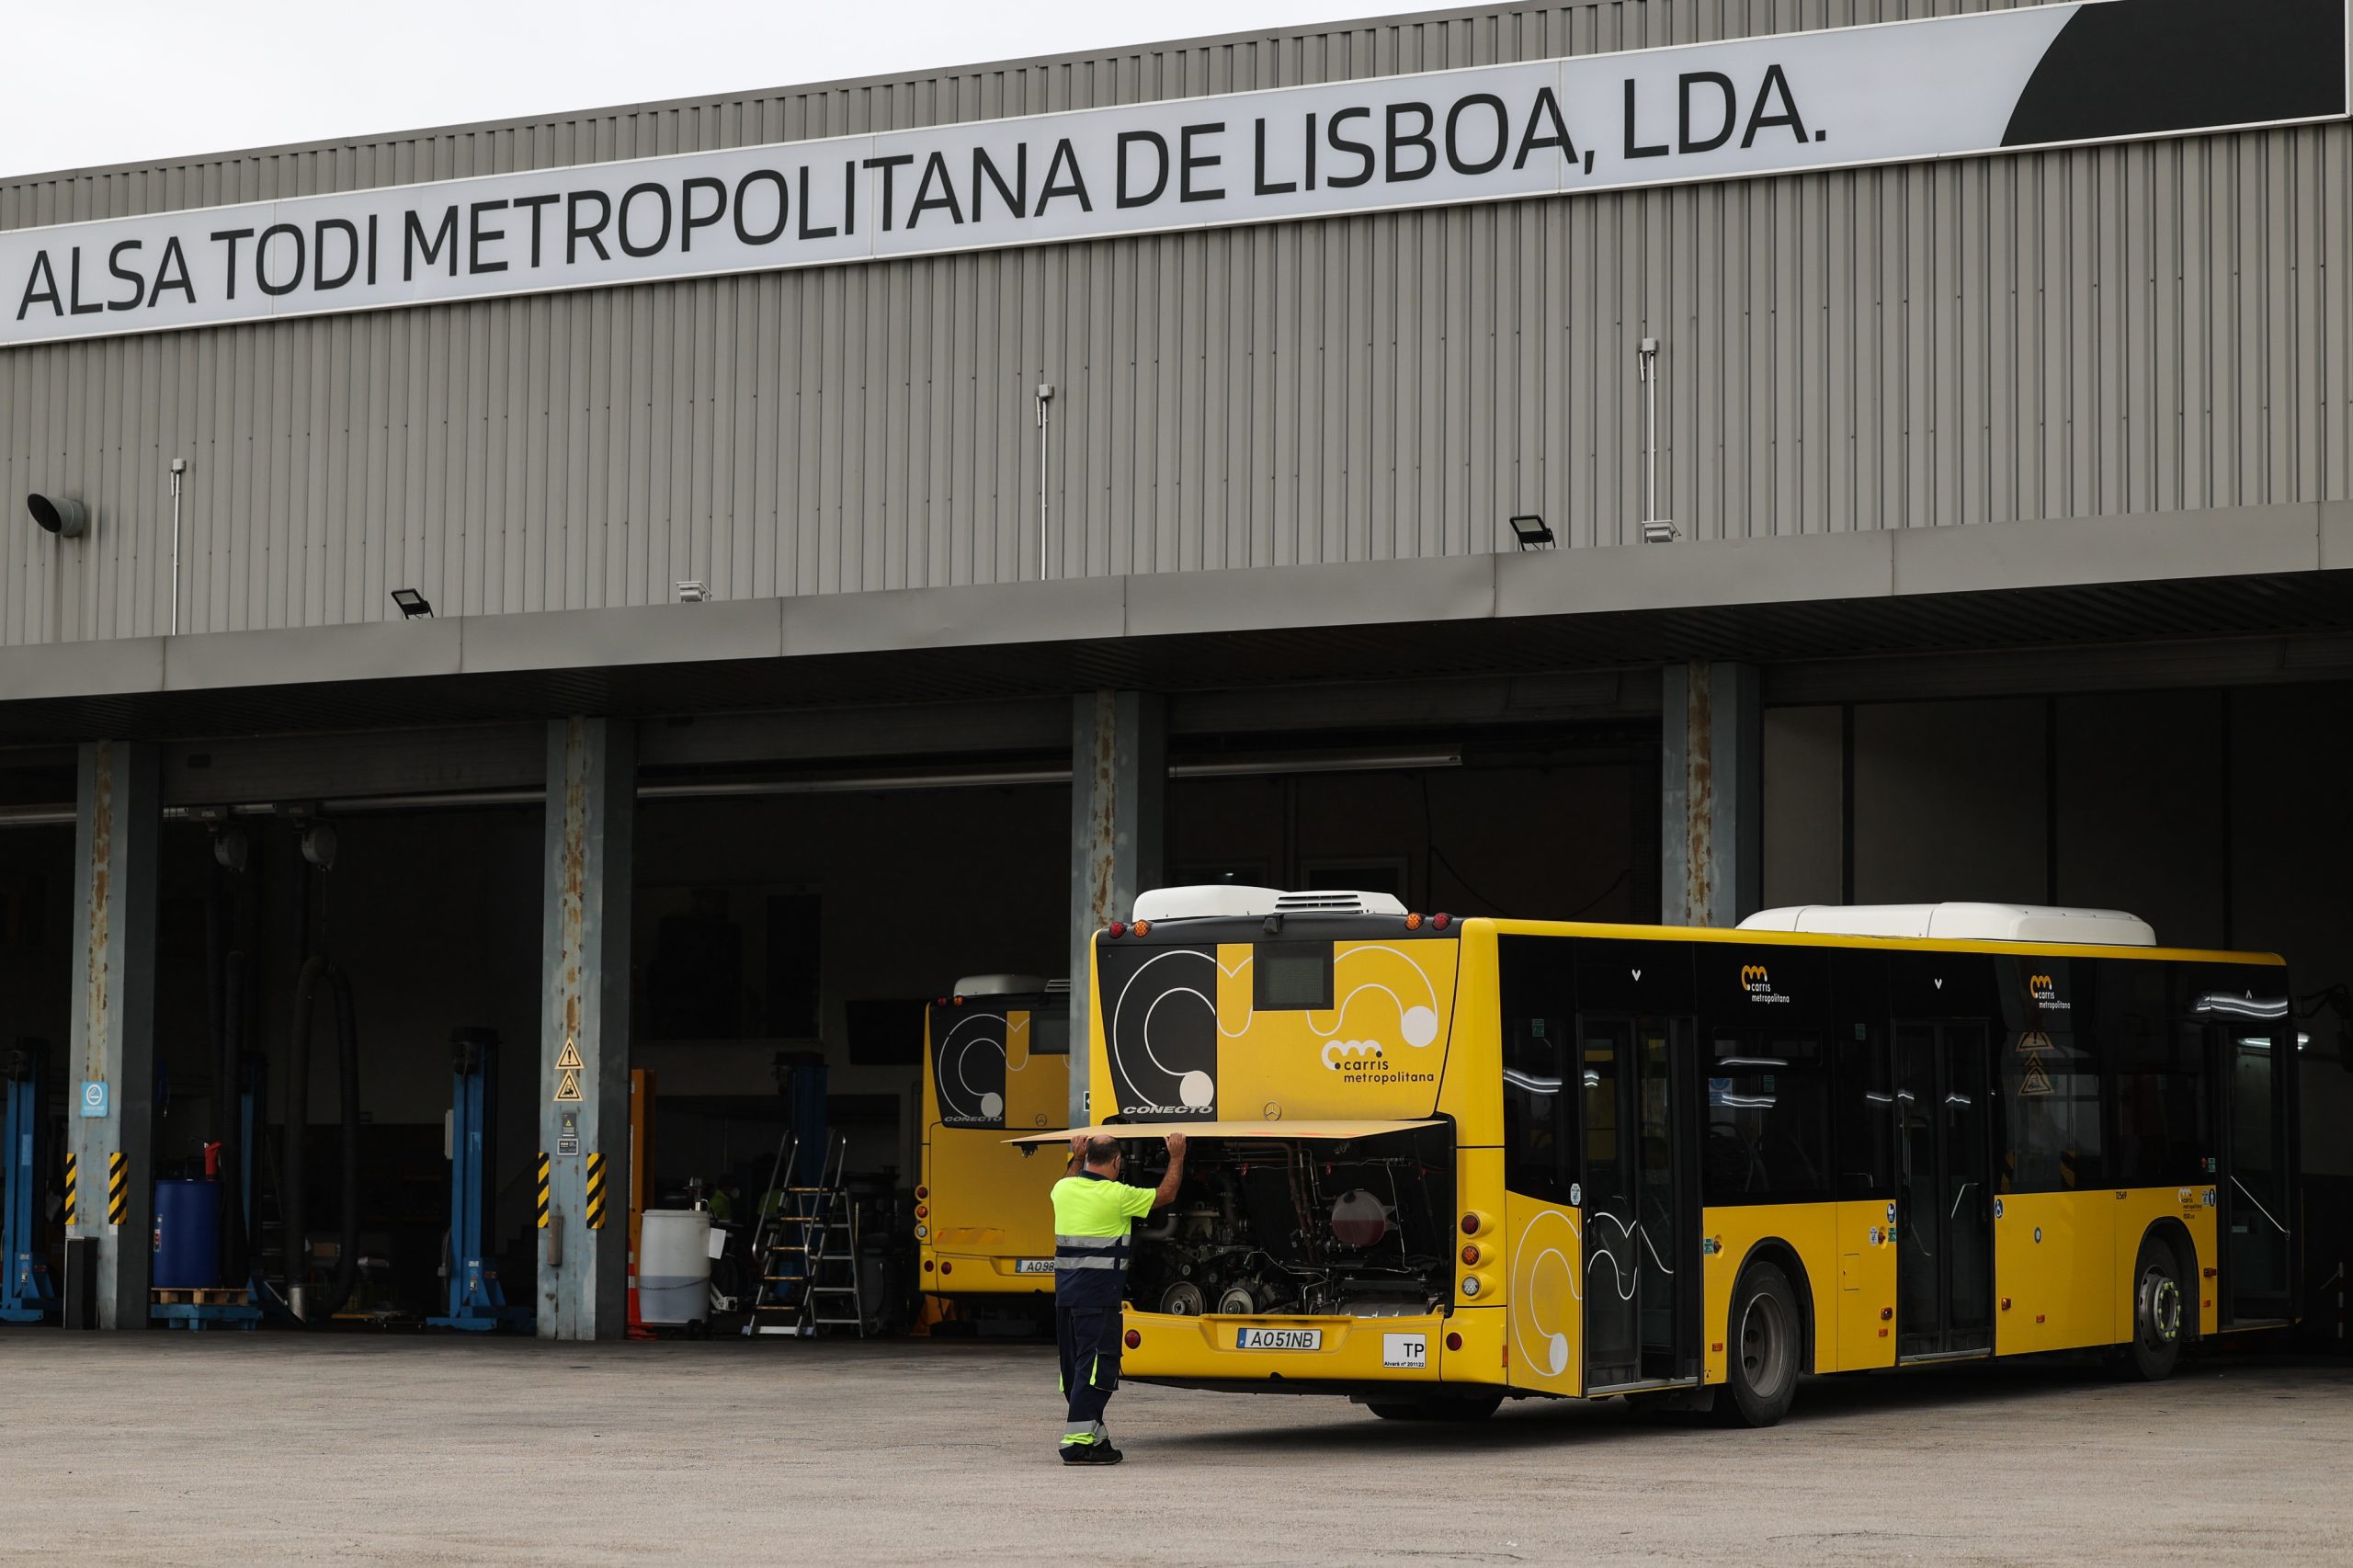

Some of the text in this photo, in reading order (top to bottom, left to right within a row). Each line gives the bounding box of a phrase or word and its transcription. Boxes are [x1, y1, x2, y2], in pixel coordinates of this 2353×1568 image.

[16, 63, 1826, 321] ALSA TODI METROPOLITANA DE LISBOA, LDA.
[1751, 983, 1771, 992] carris
[1751, 993, 1790, 1005] metropolitana
[1344, 1060, 1389, 1071] carris
[1344, 1072, 1435, 1085] metropolitana
[1122, 1105, 1213, 1115] CONECTO
[1250, 1331, 1313, 1348] AO51NB
[1403, 1343, 1425, 1358] TP
